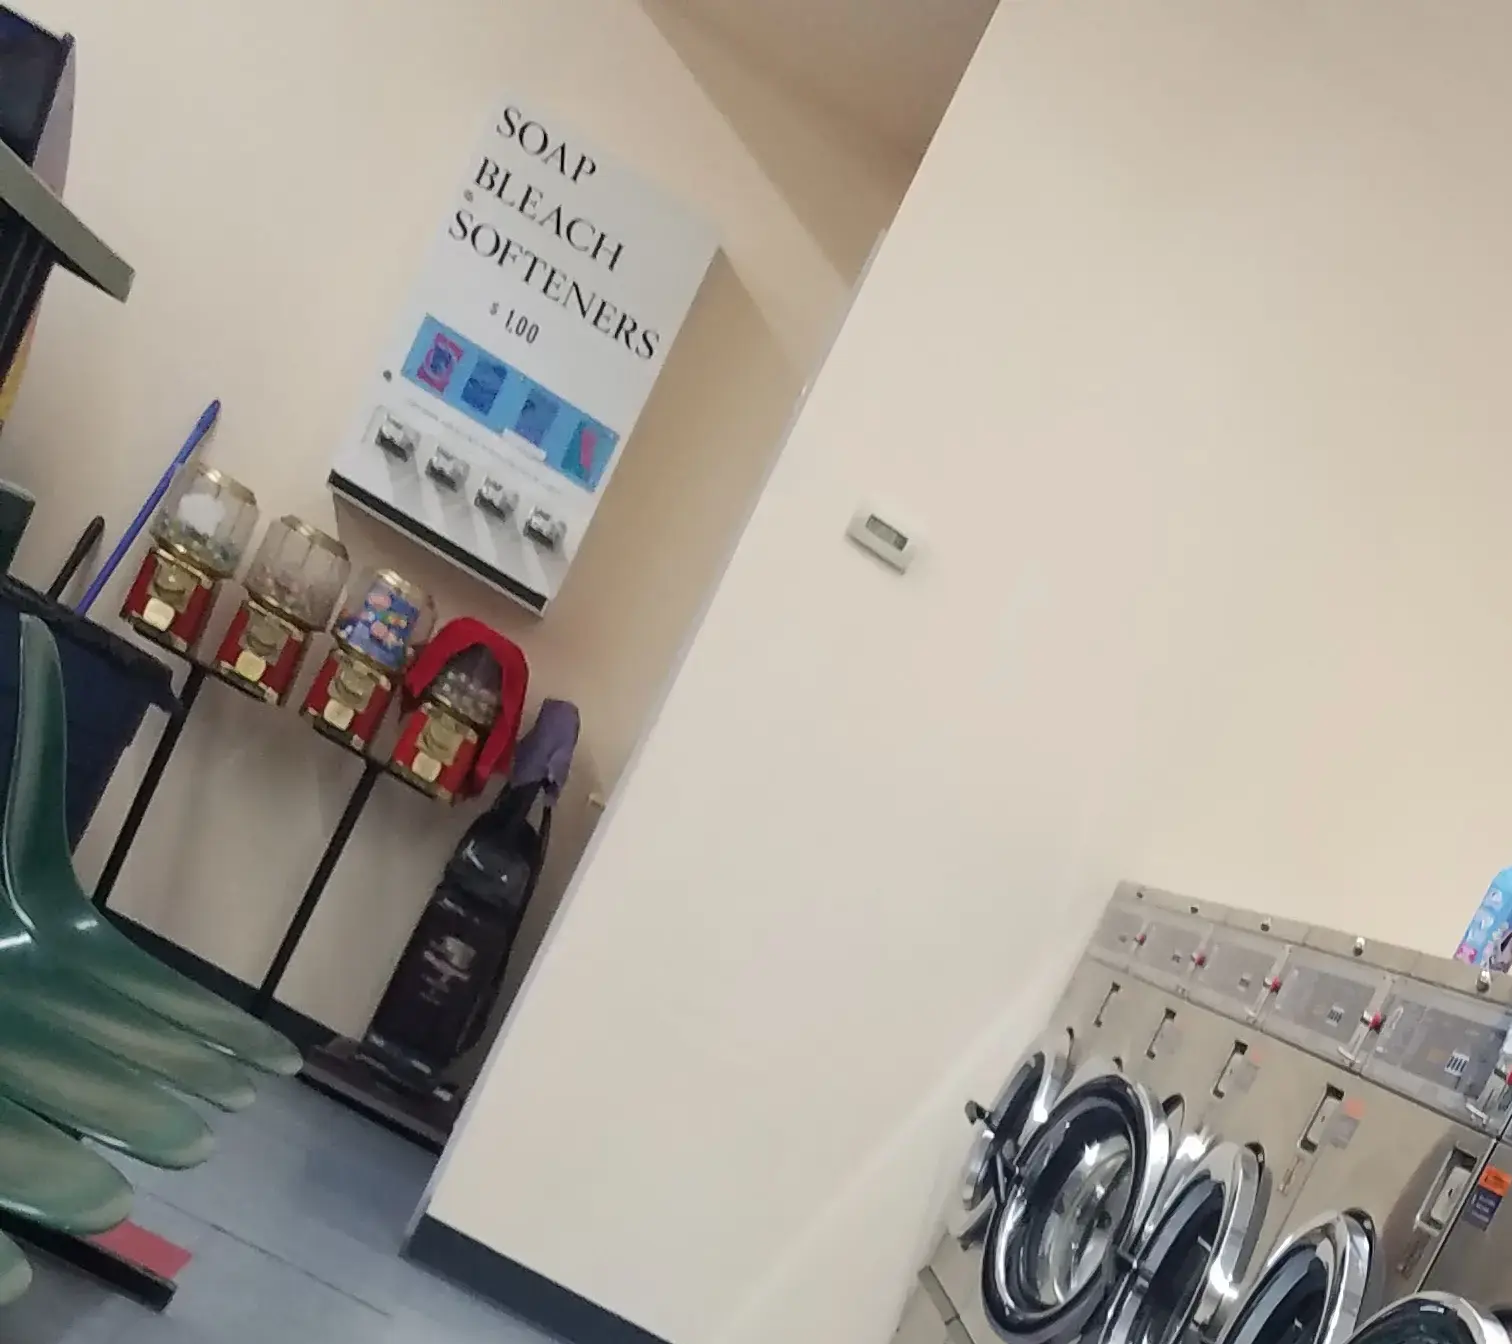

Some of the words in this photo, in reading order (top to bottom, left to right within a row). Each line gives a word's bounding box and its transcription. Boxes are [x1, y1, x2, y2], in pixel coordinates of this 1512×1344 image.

[495, 105, 598, 185] SOAP
[474, 157, 625, 273] BLEACH
[448, 208, 661, 361] SOFTENERS
